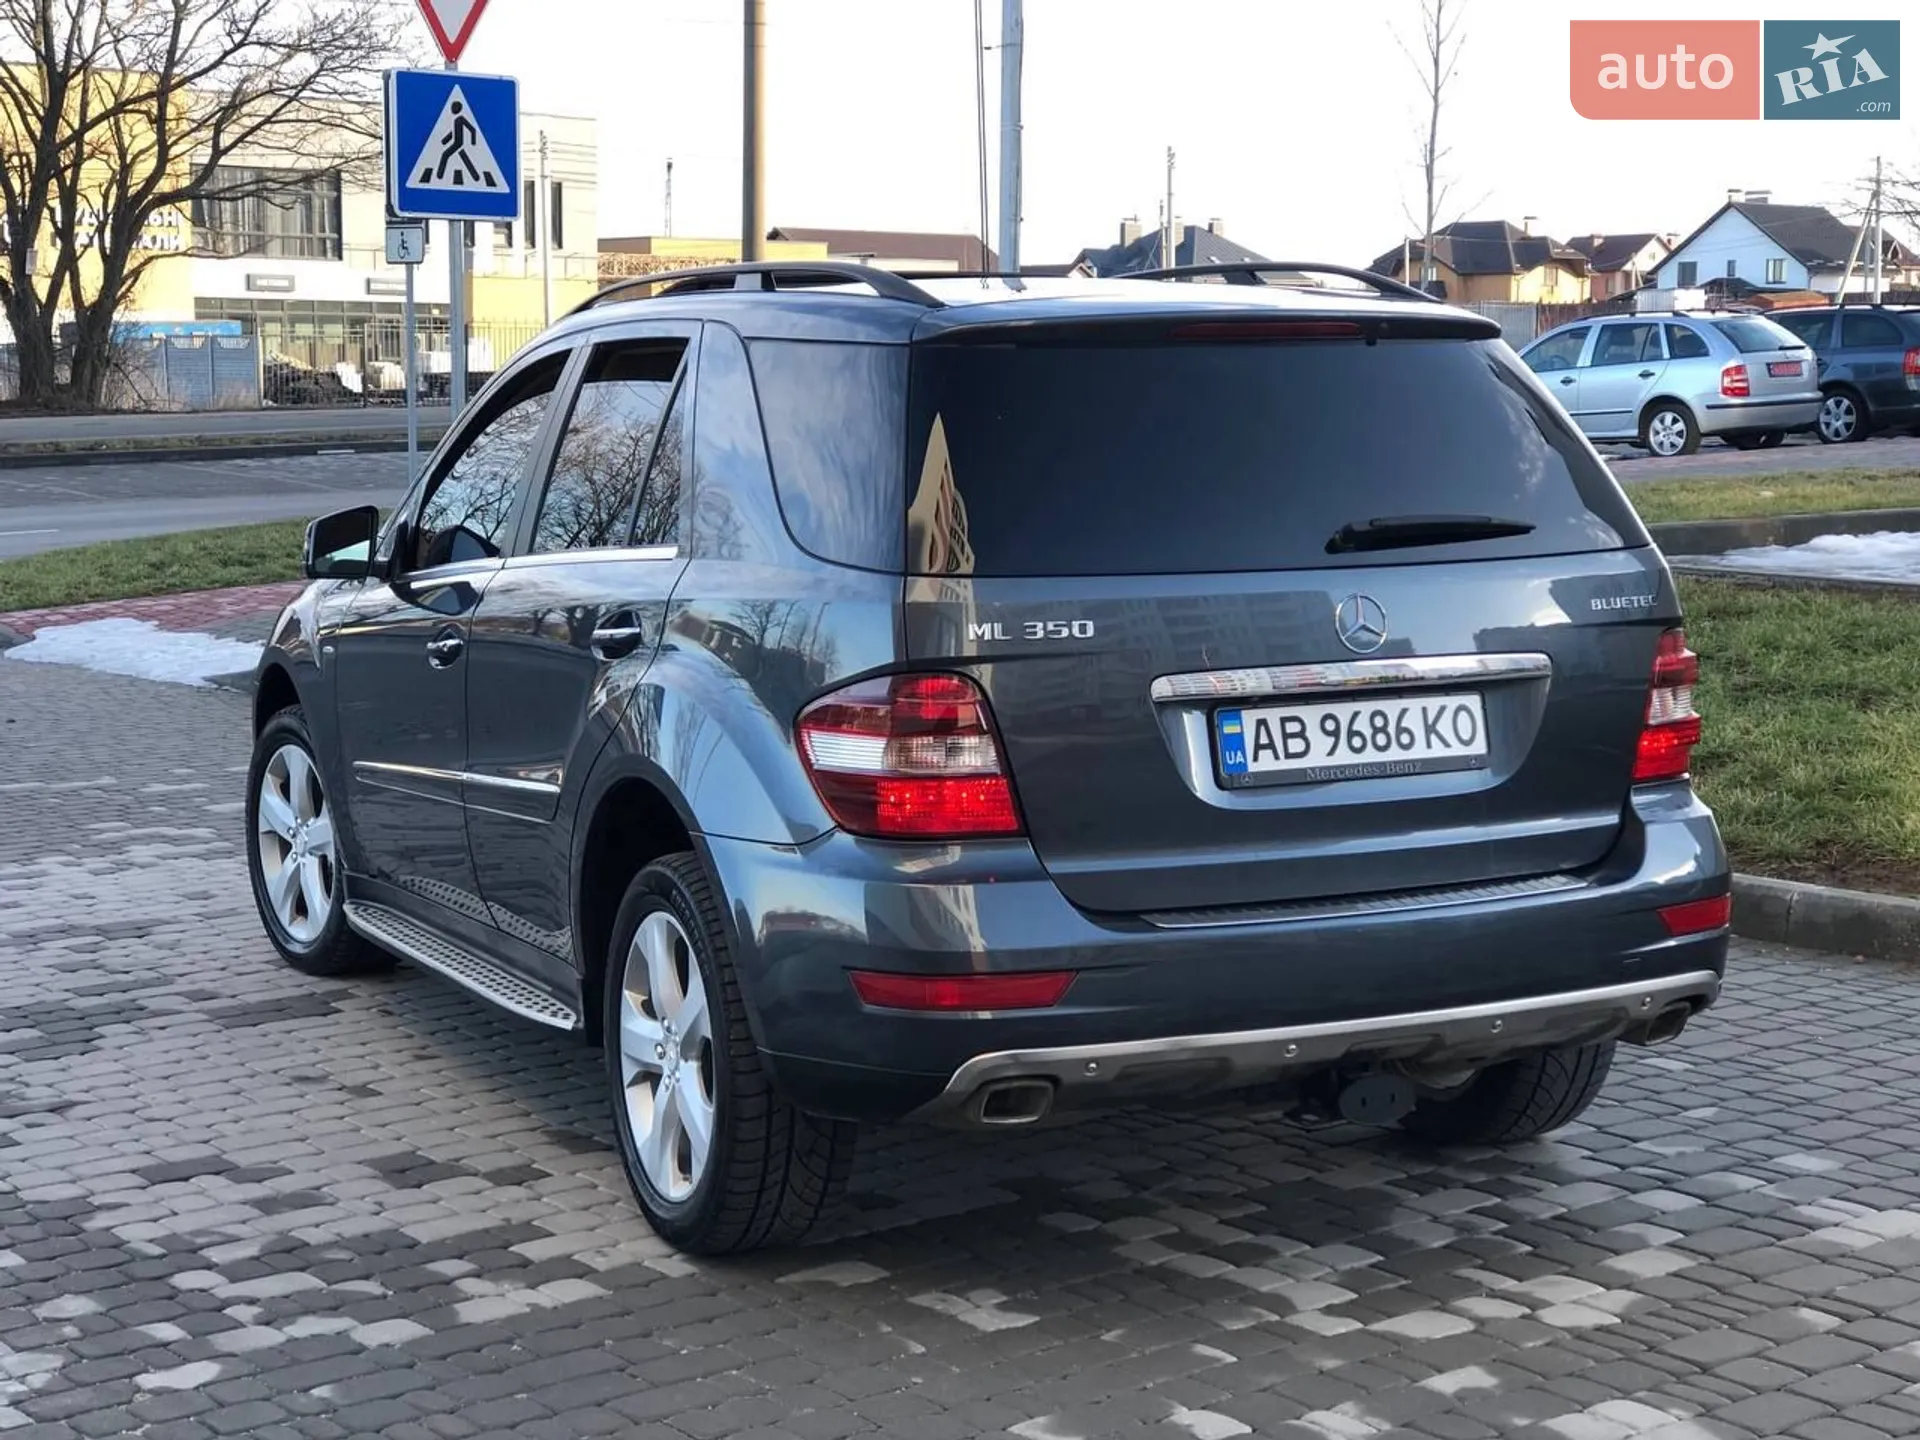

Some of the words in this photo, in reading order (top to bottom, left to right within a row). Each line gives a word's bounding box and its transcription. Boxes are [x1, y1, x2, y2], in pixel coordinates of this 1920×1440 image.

[1590, 594, 1658, 611] BLUETEC
[968, 621, 1013, 641] ML
[1023, 619, 1095, 640] 350
[1226, 751, 1245, 765] UA
[1306, 761, 1422, 782] Mercedes-Benz
